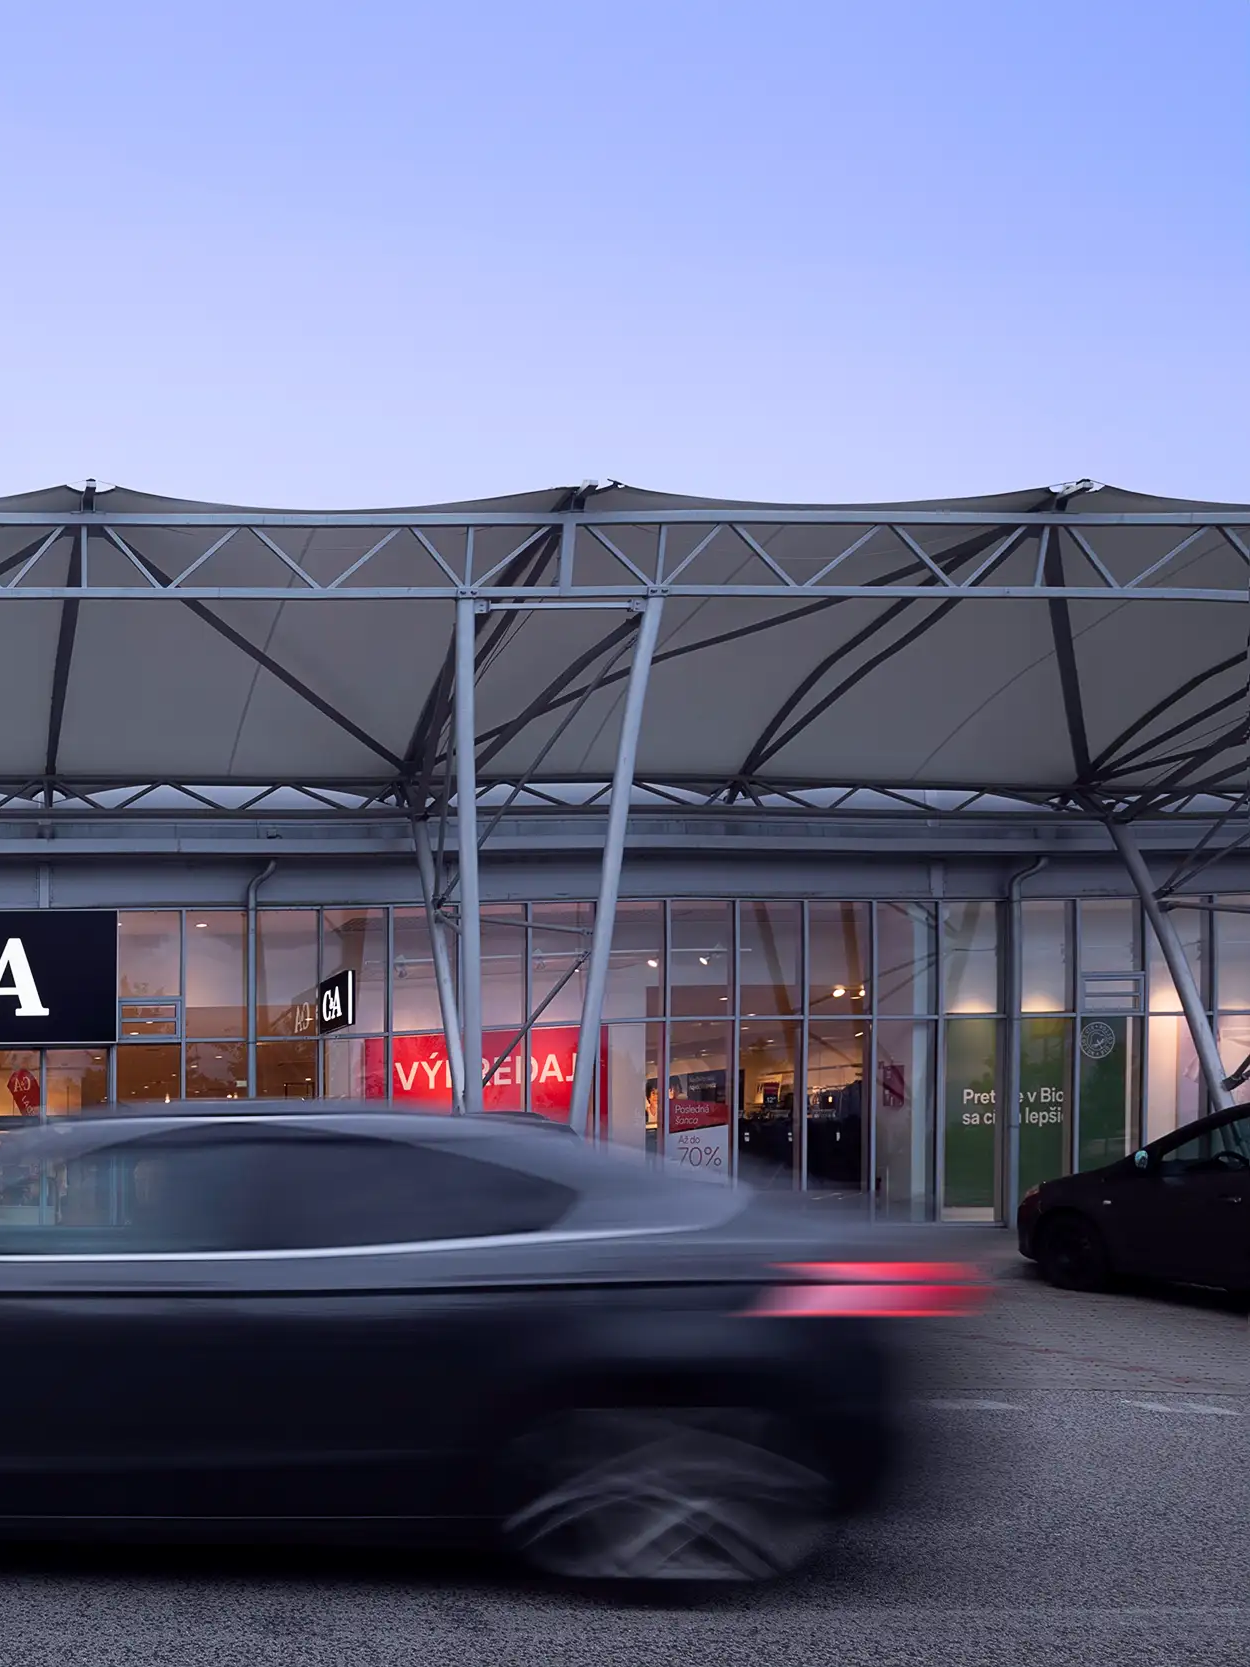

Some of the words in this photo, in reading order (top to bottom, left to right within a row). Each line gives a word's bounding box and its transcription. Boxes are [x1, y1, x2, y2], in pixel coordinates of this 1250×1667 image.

[322, 985, 343, 1022] C&A
[395, 1052, 579, 1091] VÝEDAJ
[1027, 1092, 1037, 1101] v
[675, 1104, 710, 1114] Posledná
[962, 1115, 980, 1125] sa
[1025, 1107, 1064, 1127] lepši
[678, 1135, 689, 1144] Až
[690, 1135, 701, 1144] do
[677, 1146, 722, 1167] 70%
